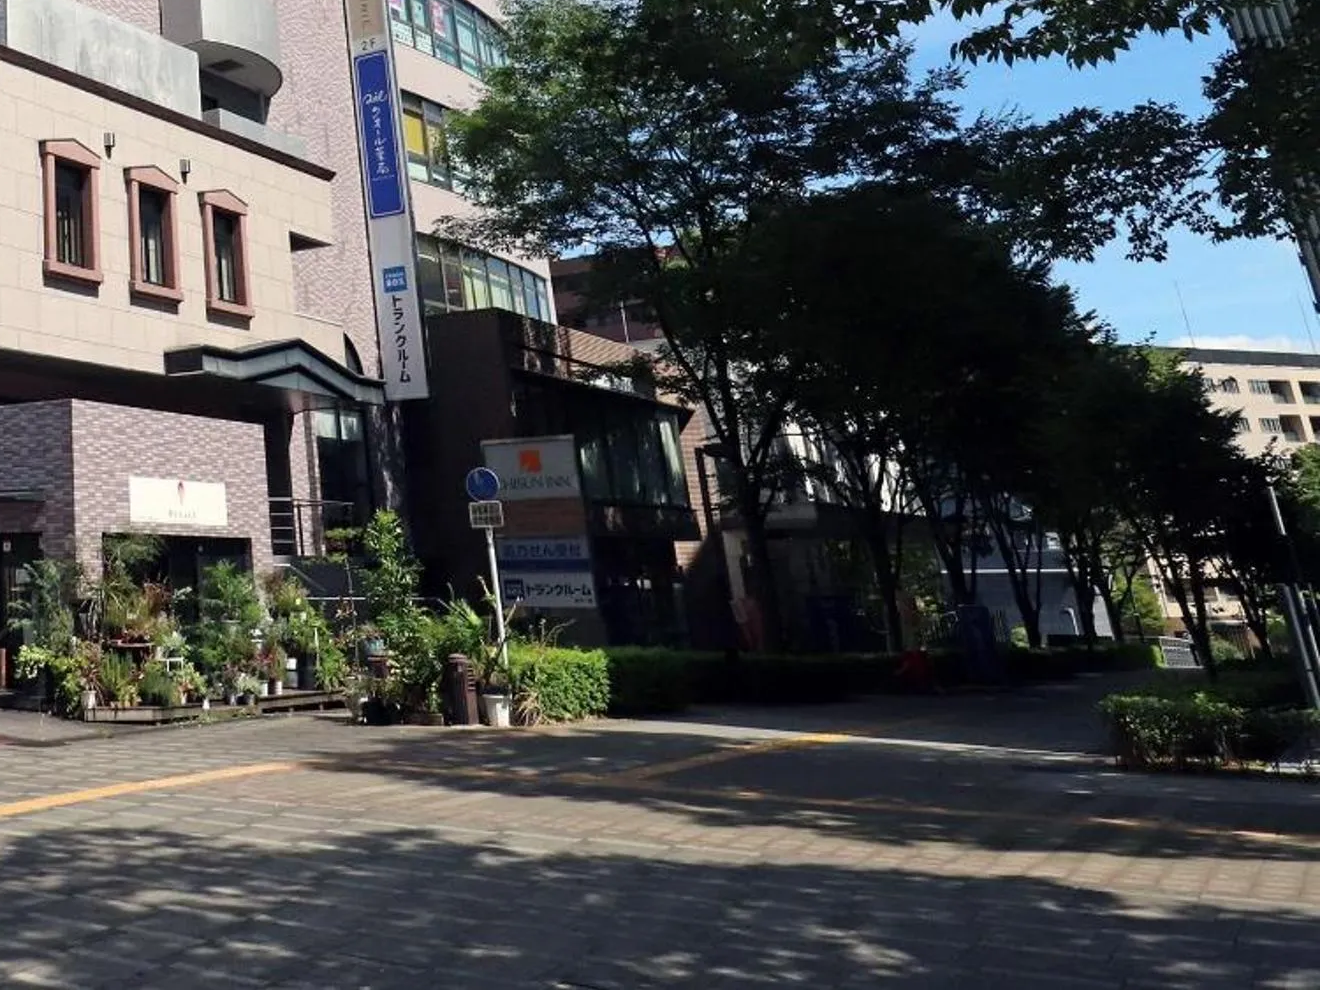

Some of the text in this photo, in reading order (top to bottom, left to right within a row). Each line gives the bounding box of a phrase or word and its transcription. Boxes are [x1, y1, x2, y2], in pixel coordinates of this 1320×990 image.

[361, 38, 377, 51] 2F
[391, 294, 411, 383] トランクルーム
[526, 583, 592, 596] トランクルーム
